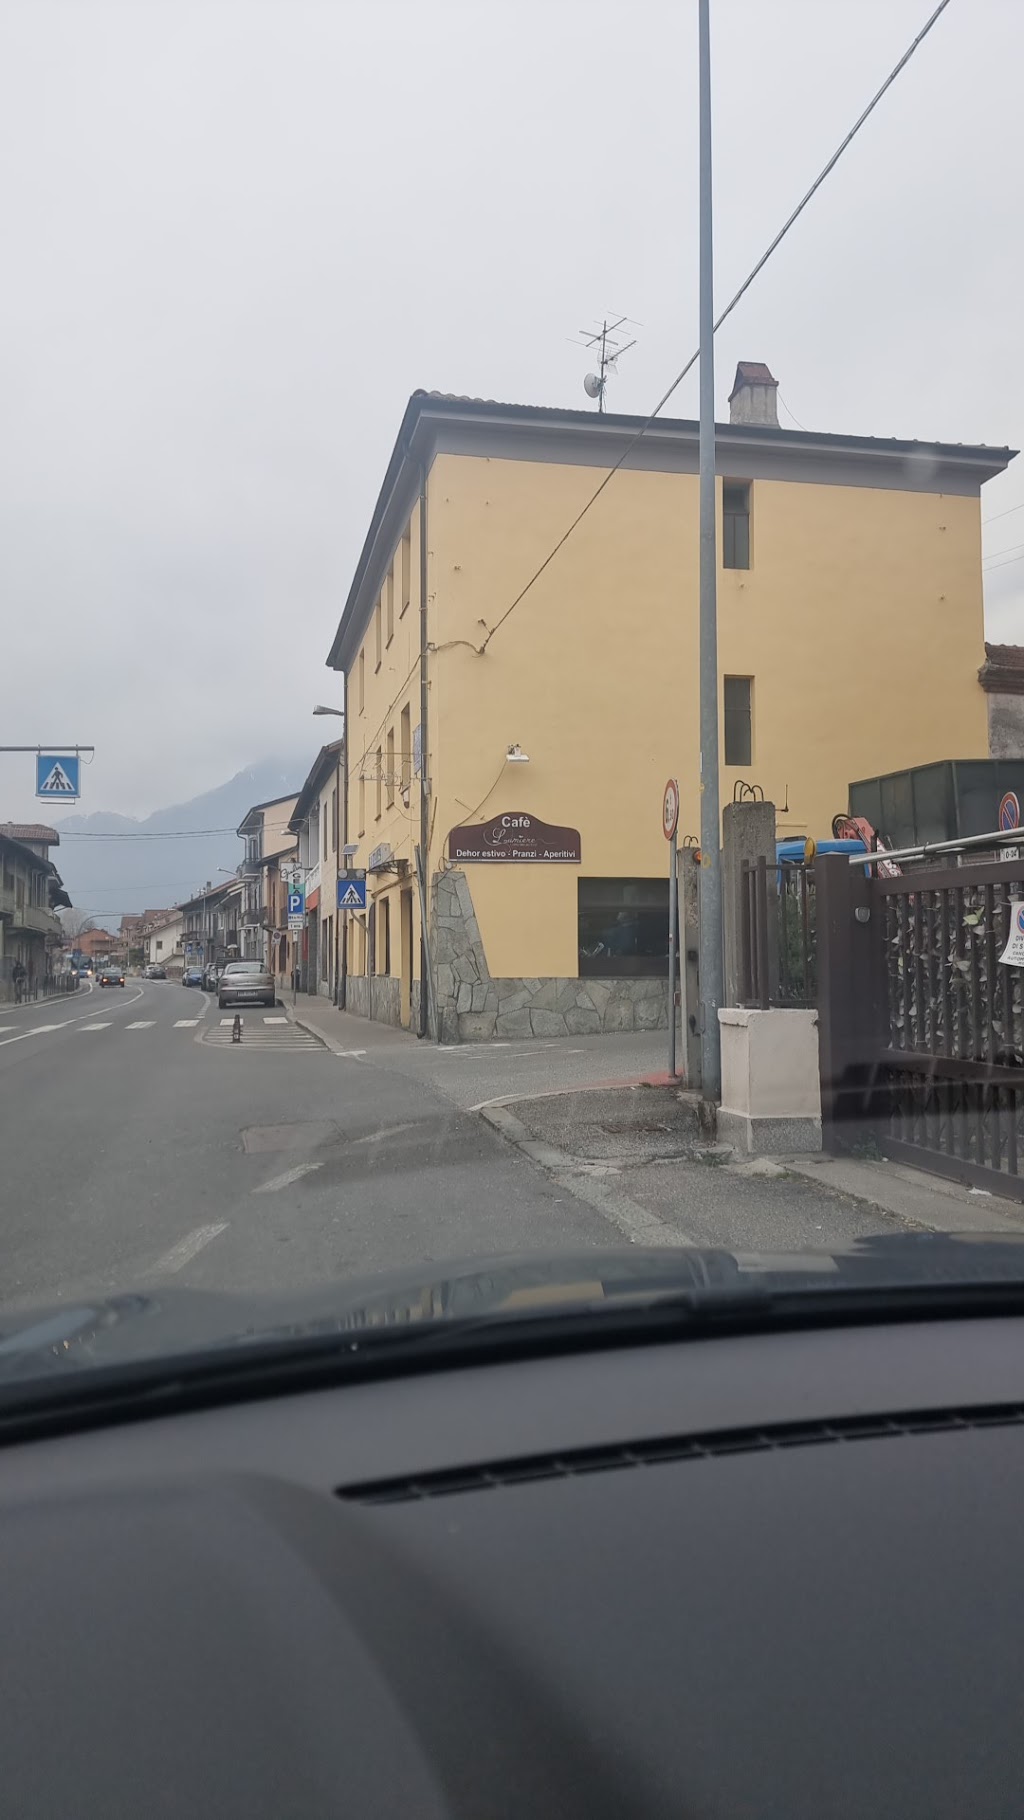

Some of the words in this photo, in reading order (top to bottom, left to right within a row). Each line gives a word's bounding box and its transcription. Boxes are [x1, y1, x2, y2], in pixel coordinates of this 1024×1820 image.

[501, 816, 531, 828] Cafè
[456, 849, 480, 857] Dehor
[482, 849, 505, 857] estivo
[512, 850, 537, 858] Pranzi
[544, 850, 576, 859] Aperitivi
[290, 896, 300, 911] P
